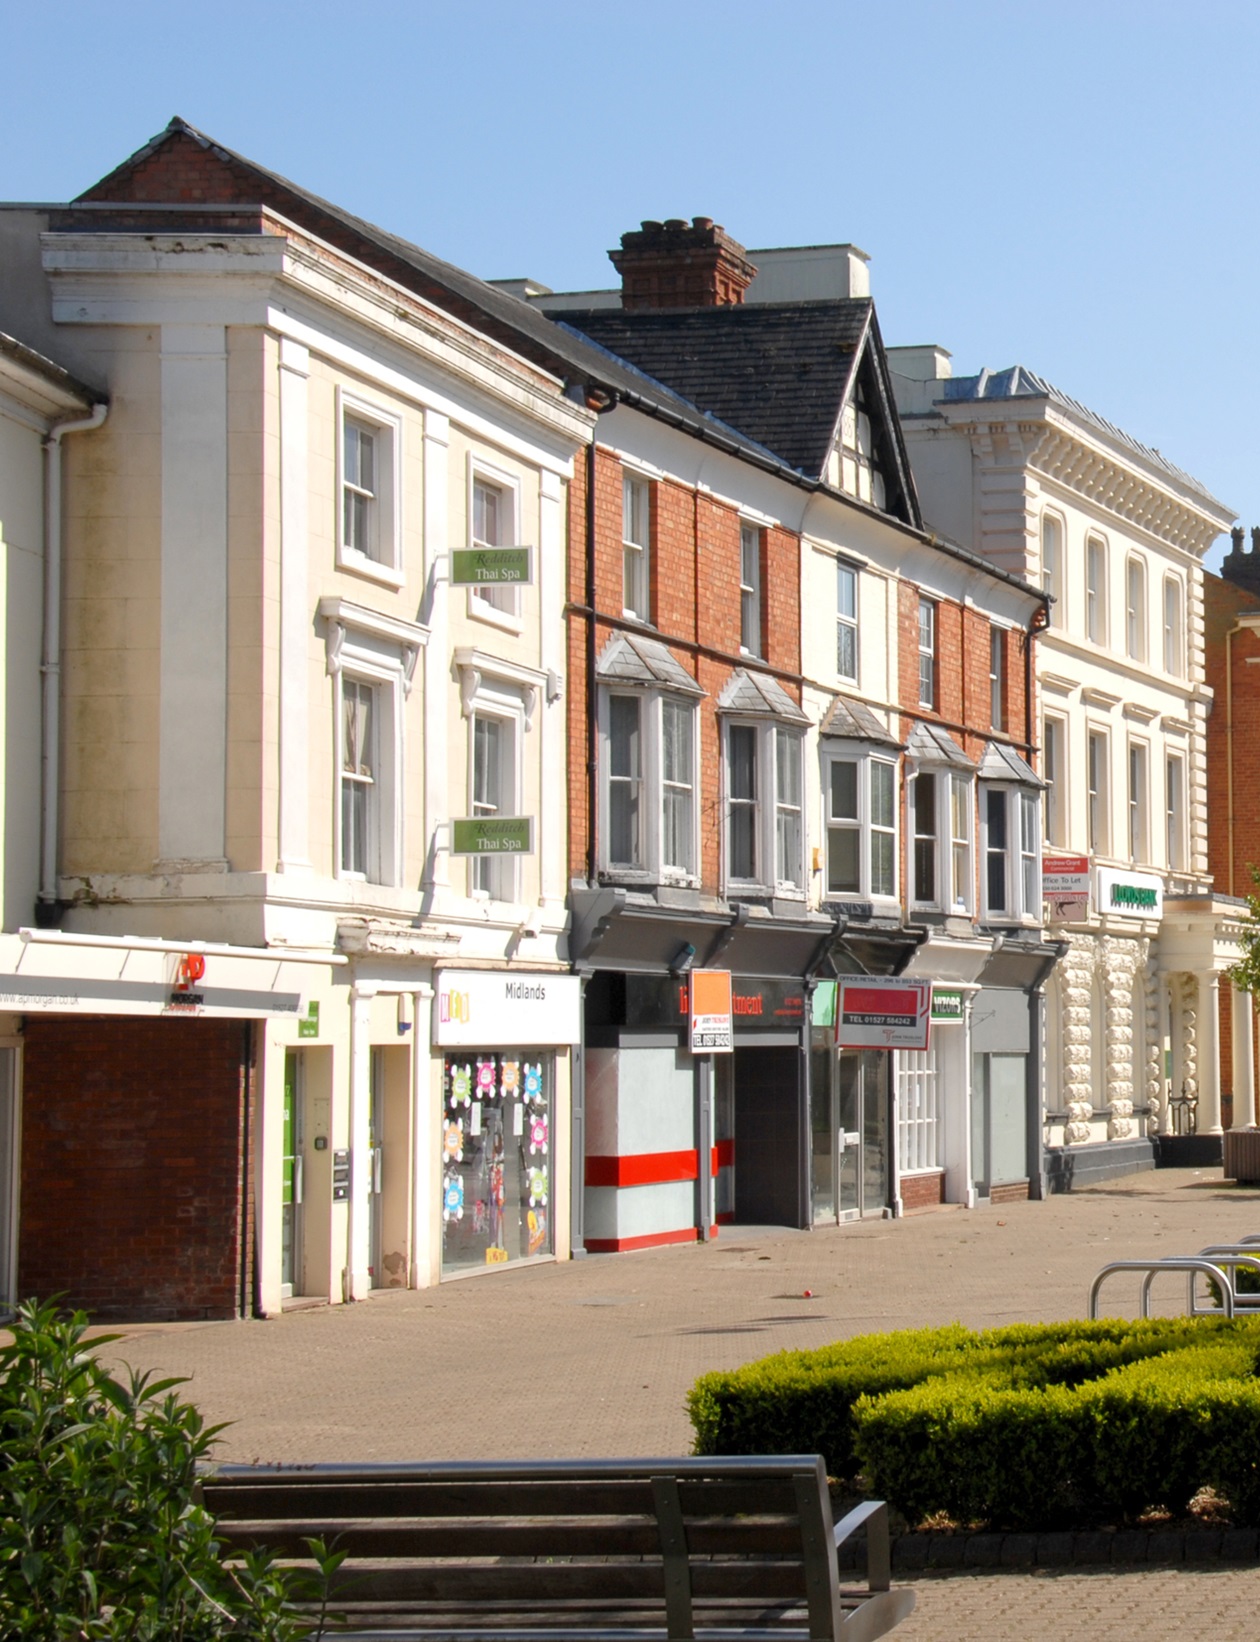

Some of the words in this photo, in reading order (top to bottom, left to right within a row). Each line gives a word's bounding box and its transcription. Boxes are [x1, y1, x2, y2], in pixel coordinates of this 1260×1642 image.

[475, 552, 523, 567] Redditch
[475, 568, 499, 580] Thai
[501, 567, 520, 581] Spa
[475, 821, 525, 837] Redditch
[476, 837, 500, 850] Thai
[502, 837, 522, 851] Spa
[1042, 876, 1059, 884] ffice
[505, 982, 546, 1000] Midlands
[933, 996, 961, 1014] VIZORS
[849, 1015, 863, 1023] TEL
[864, 1016, 885, 1024] 01527
